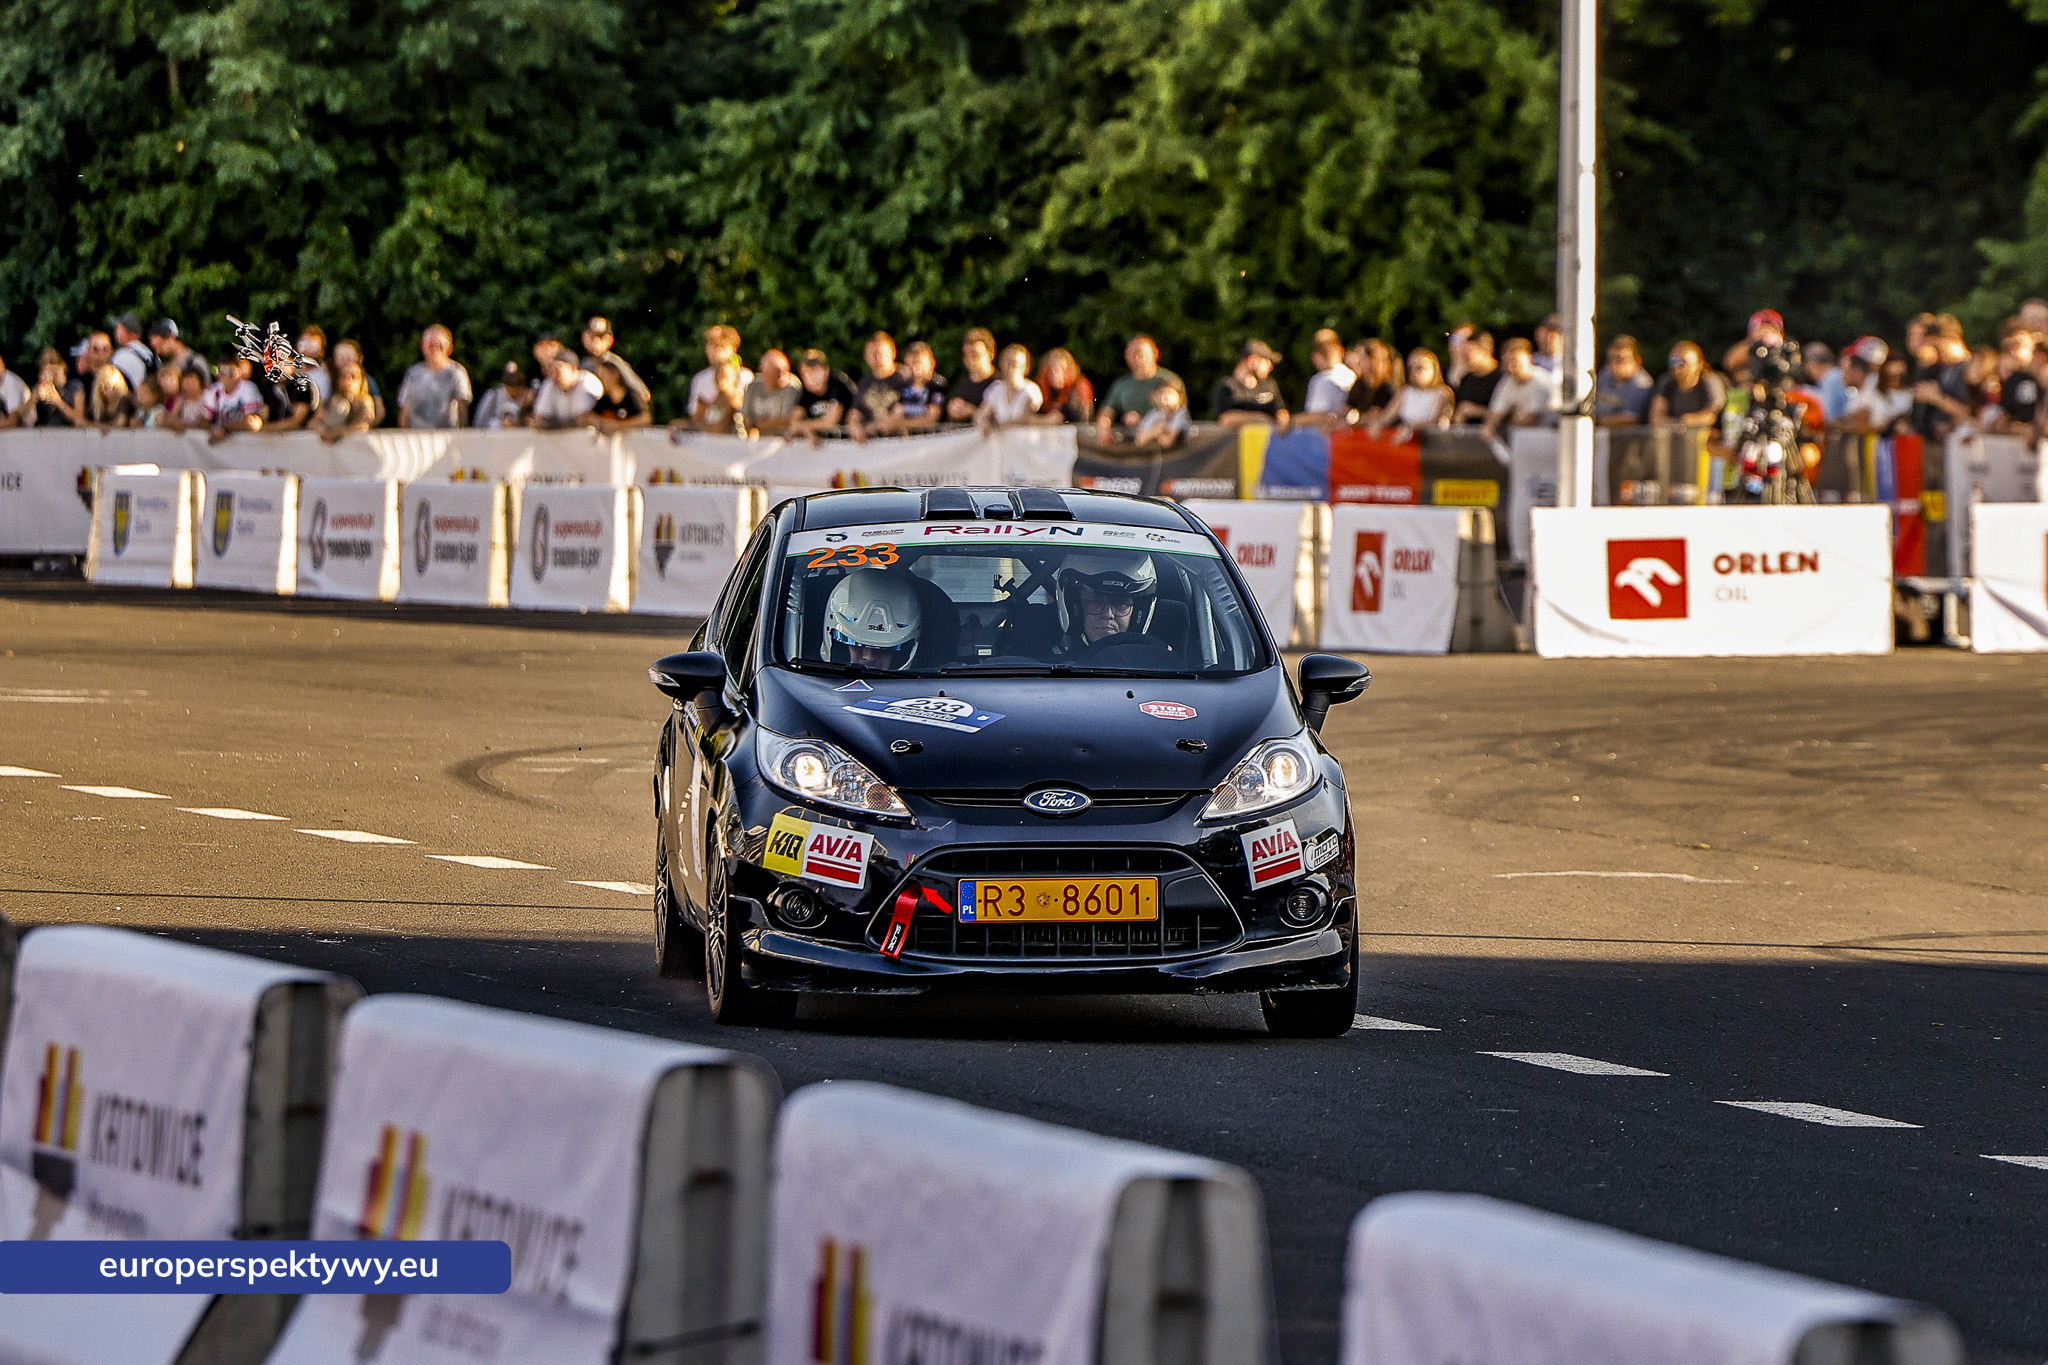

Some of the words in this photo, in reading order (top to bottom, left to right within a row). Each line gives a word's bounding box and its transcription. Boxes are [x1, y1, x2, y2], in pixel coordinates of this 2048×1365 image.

[807, 543, 900, 569] 233
[1713, 551, 1819, 576] ORLEN
[909, 699, 965, 713] 233
[1039, 790, 1075, 808] Ford
[962, 905, 975, 914] PL
[983, 884, 1026, 917] R3
[1063, 883, 1140, 916] 8601
